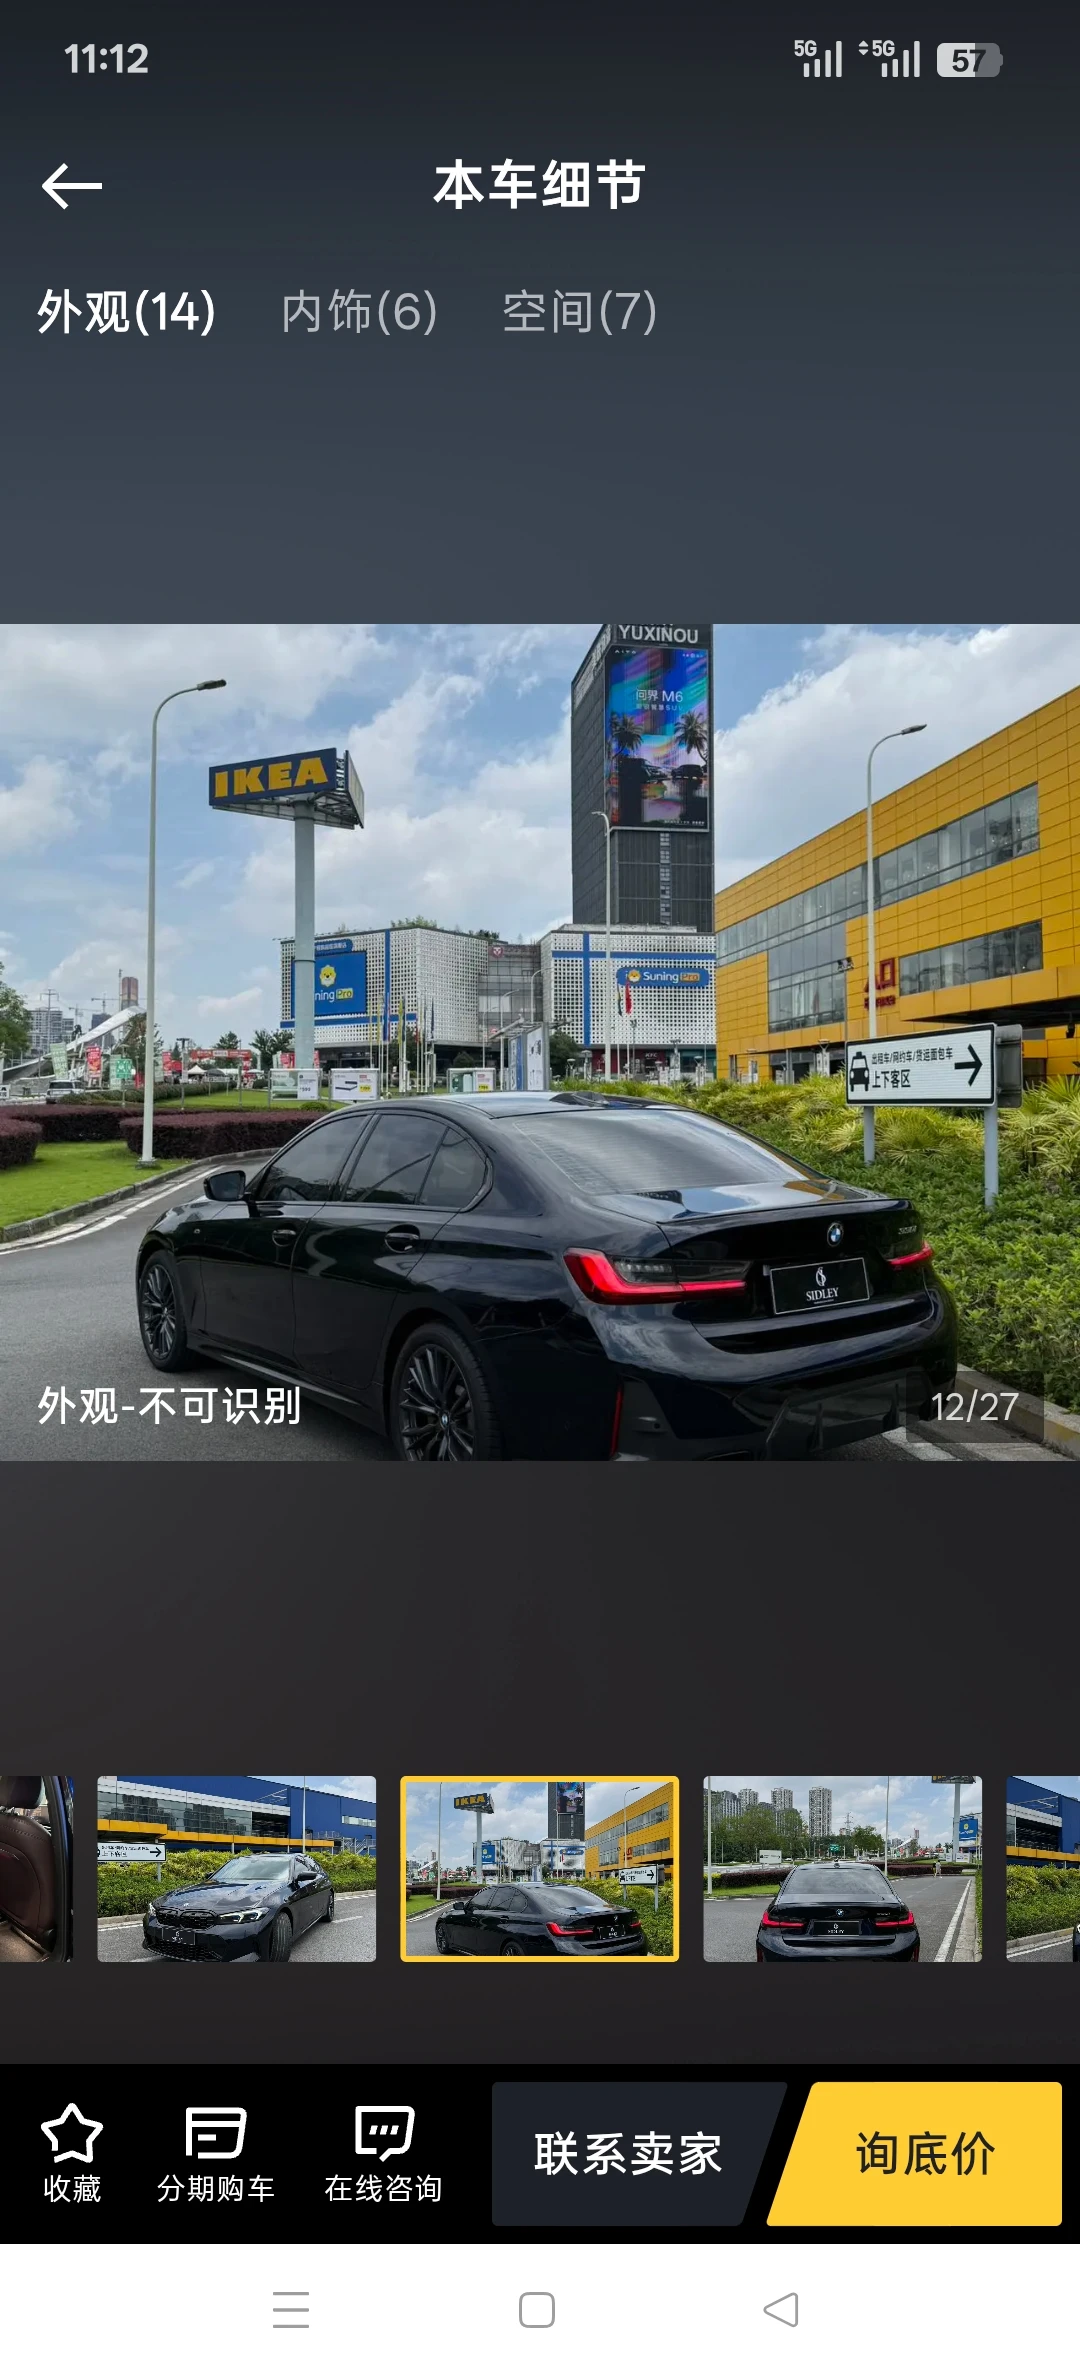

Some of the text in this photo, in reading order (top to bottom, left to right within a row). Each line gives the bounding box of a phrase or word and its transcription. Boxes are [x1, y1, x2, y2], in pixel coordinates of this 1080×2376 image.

[619, 625, 699, 644] YUXINOU
[635, 689, 684, 703] 问界 M6
[214, 757, 329, 798] IKEA
[643, 971, 679, 984] Suning
[315, 989, 353, 1003] ning Pro
[871, 1046, 953, 1065] 出租车/网约车/货运面包车
[872, 1069, 911, 1088] 上下客区
[806, 1287, 839, 1301] SIDLEY
